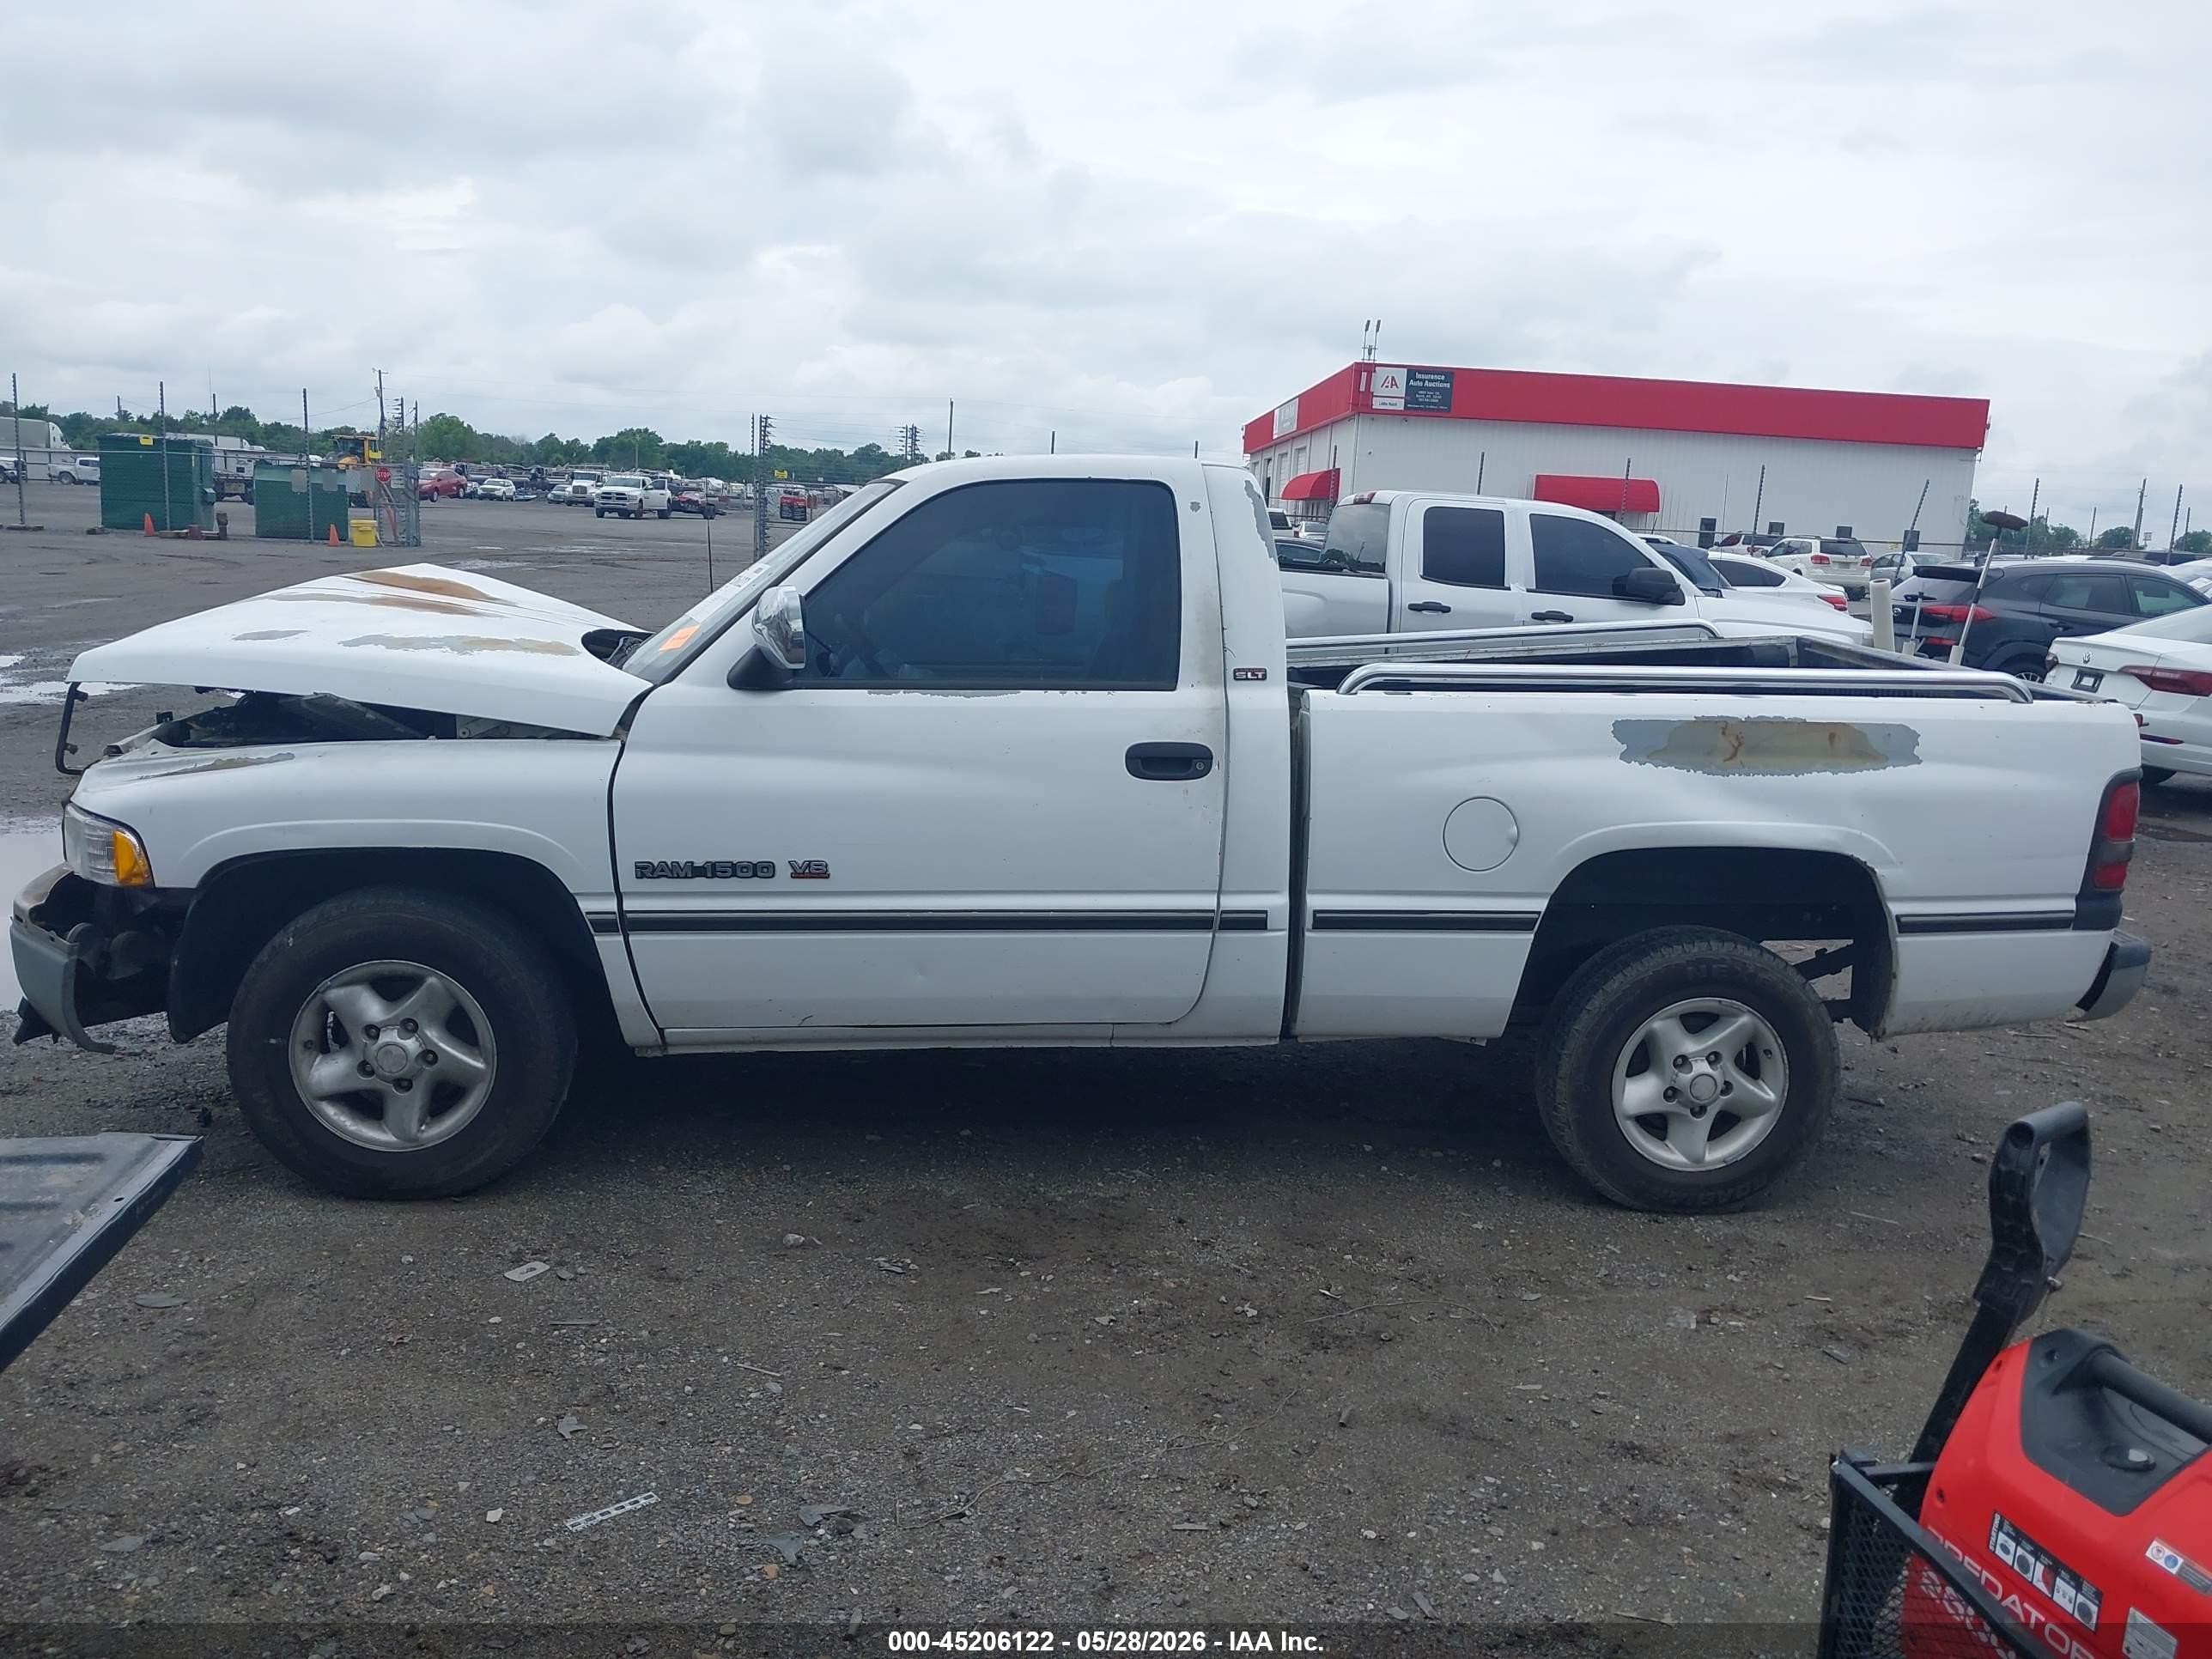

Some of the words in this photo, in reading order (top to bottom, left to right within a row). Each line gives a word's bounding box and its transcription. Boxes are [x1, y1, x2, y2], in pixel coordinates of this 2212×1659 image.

[1415, 372, 1445, 380] Insurance
[635, 861, 694, 878] RAM
[702, 861, 775, 878] 1500
[788, 860, 828, 873] V8
